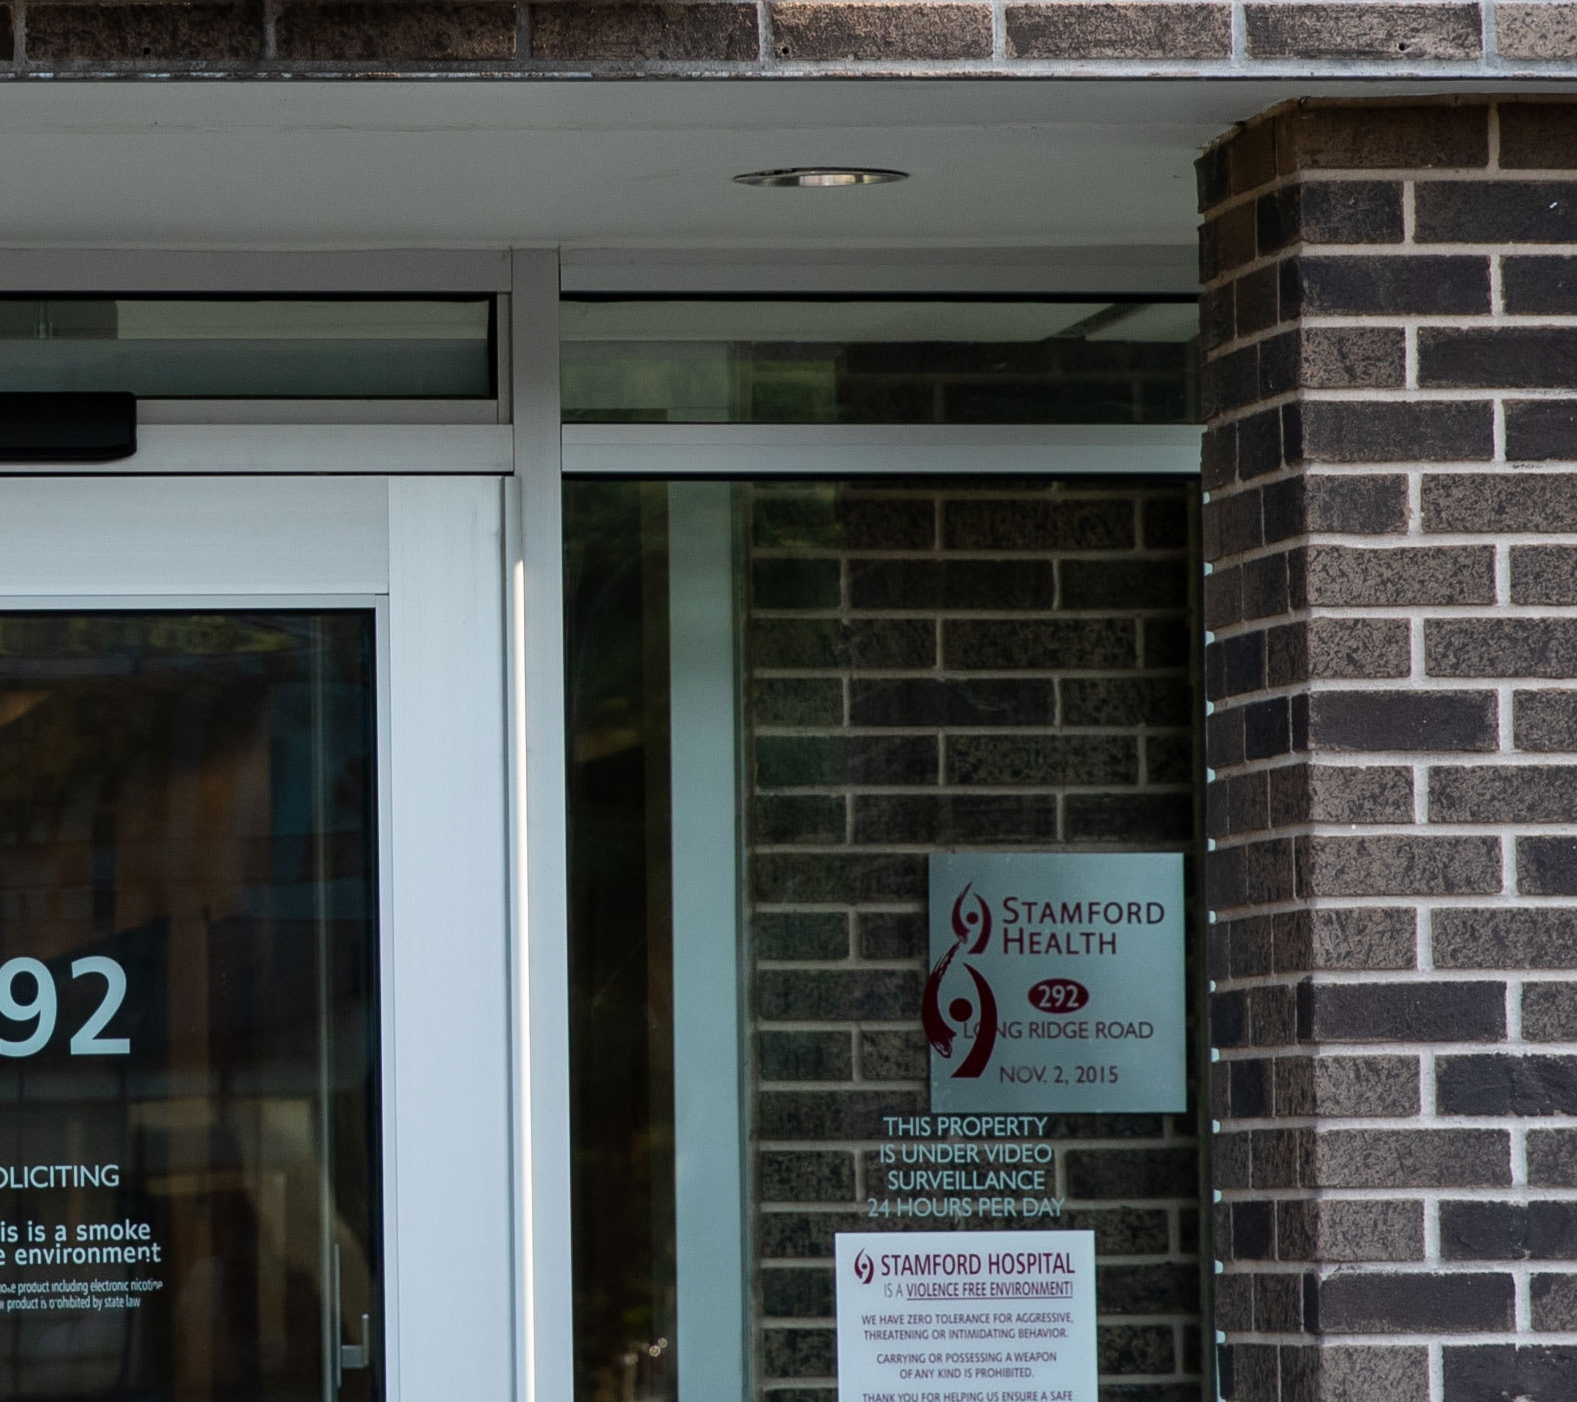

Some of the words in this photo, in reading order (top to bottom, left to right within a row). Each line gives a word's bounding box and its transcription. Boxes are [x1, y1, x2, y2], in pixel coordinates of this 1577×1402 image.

[1002, 896, 1165, 925] STAMFORD
[1003, 927, 1116, 955] HEALTH
[1039, 985, 1079, 1008] 292
[1029, 1021, 1089, 1039] RIDGE
[1095, 1021, 1154, 1039] ROAD
[999, 1065, 1047, 1084] NOV.
[1053, 1065, 1069, 1085] 2,
[1075, 1065, 1119, 1084] 2015
[883, 1117, 931, 1136] THIS
[937, 1116, 1048, 1136] PROPERTY
[880, 1144, 895, 1163] IS
[902, 1144, 980, 1163] UNDER
[984, 1143, 1052, 1163] VIDEO
[888, 1170, 1045, 1190] SURVEILLANCE
[867, 1198, 890, 1218] 24
[897, 1197, 972, 1218] HOURS
[978, 1198, 1016, 1217] PER
[1023, 1198, 1065, 1217] DAY
[28, 1220, 46, 1242] is
[55, 1225, 67, 1242] a
[76, 1218, 150, 1242] smoke
[15, 1242, 161, 1265] environment
[881, 1253, 981, 1276] STAMFORD
[988, 1252, 1075, 1275] HOSPITAL
[884, 1283, 893, 1298] IS
[896, 1283, 903, 1297] A
[906, 1282, 959, 1297] VIOLENCE
[963, 1282, 986, 1297] FREE
[990, 1280, 1073, 1296] ENVIRONMENT!
[861, 1314, 876, 1325] WE
[879, 1314, 904, 1325] HAVE
[907, 1314, 933, 1325] ZERO
[935, 1313, 990, 1324] TOLERANCE
[993, 1312, 1013, 1324] FOR
[1015, 1312, 1073, 1324] AGGRESSIVE,
[864, 1329, 929, 1341] THREATENING
[931, 1329, 946, 1340] OR
[949, 1328, 1016, 1340] INTIMIDATING
[1018, 1327, 1068, 1339] BEHAVIOR.
[876, 1353, 926, 1364] CARRYING
[928, 1353, 943, 1364] OR
[946, 1352, 1003, 1363] POSSESSING
[1005, 1352, 1013, 1362] A
[1013, 1351, 1057, 1362] WEAPON
[899, 1368, 913, 1379] OF
[914, 1368, 935, 1379] ANY
[938, 1368, 962, 1379] KIND
[964, 1368, 972, 1379] IS
[975, 1367, 1034, 1378] PROHIBITED.
[863, 1393, 895, 1402] THANK
[897, 1392, 918, 1402] YOU
[921, 1392, 941, 1402] FOR
[943, 1392, 984, 1402] HELPING
[986, 1391, 999, 1402] US
[1002, 1391, 1037, 1402] ENSURE
[1040, 1391, 1048, 1401] A
[1050, 1390, 1072, 1401] SAFE
